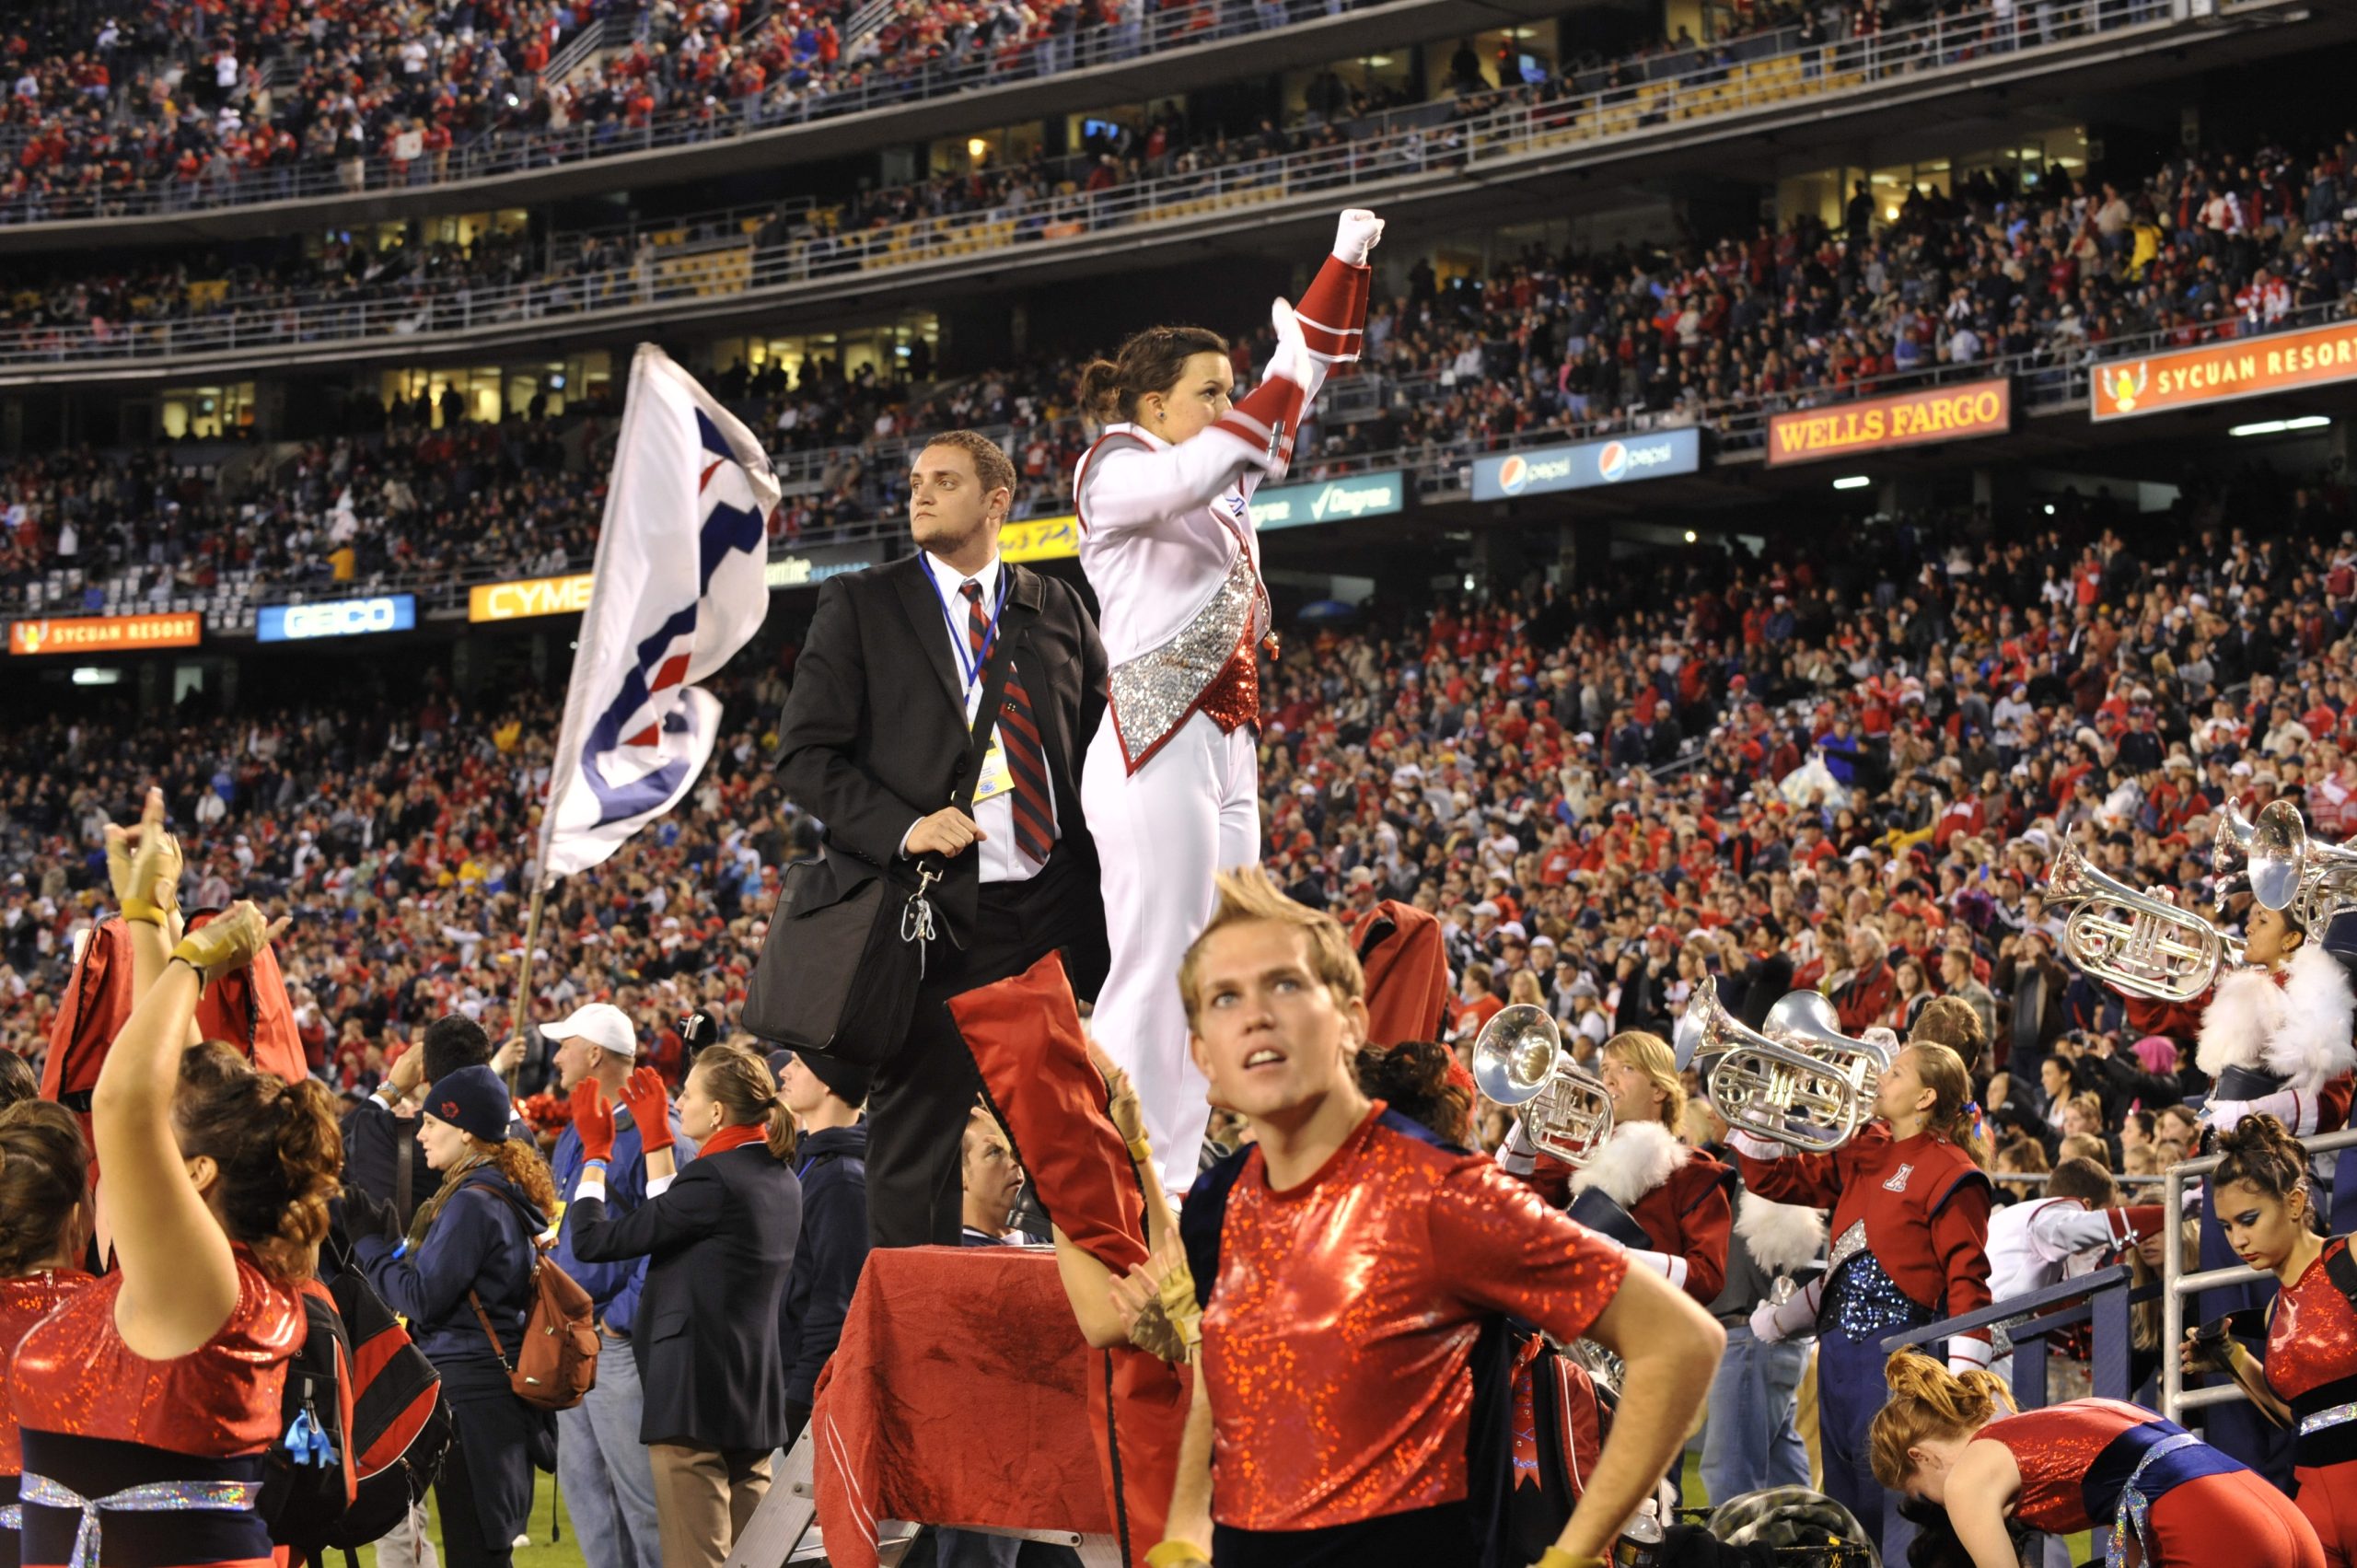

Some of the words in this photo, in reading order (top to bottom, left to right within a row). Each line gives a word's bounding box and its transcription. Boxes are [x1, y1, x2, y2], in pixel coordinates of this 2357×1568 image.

[2157, 356, 2256, 394] SYCUAN
[1777, 410, 1886, 452] WELLS
[1890, 390, 2001, 437] FARGO
[1527, 457, 1571, 483] pepsi
[1627, 443, 1672, 470] pepsi
[488, 577, 592, 618] CYME
[52, 625, 122, 645] SYCUAN
[127, 619, 195, 641] RESORT
[284, 598, 394, 638] GEICO
